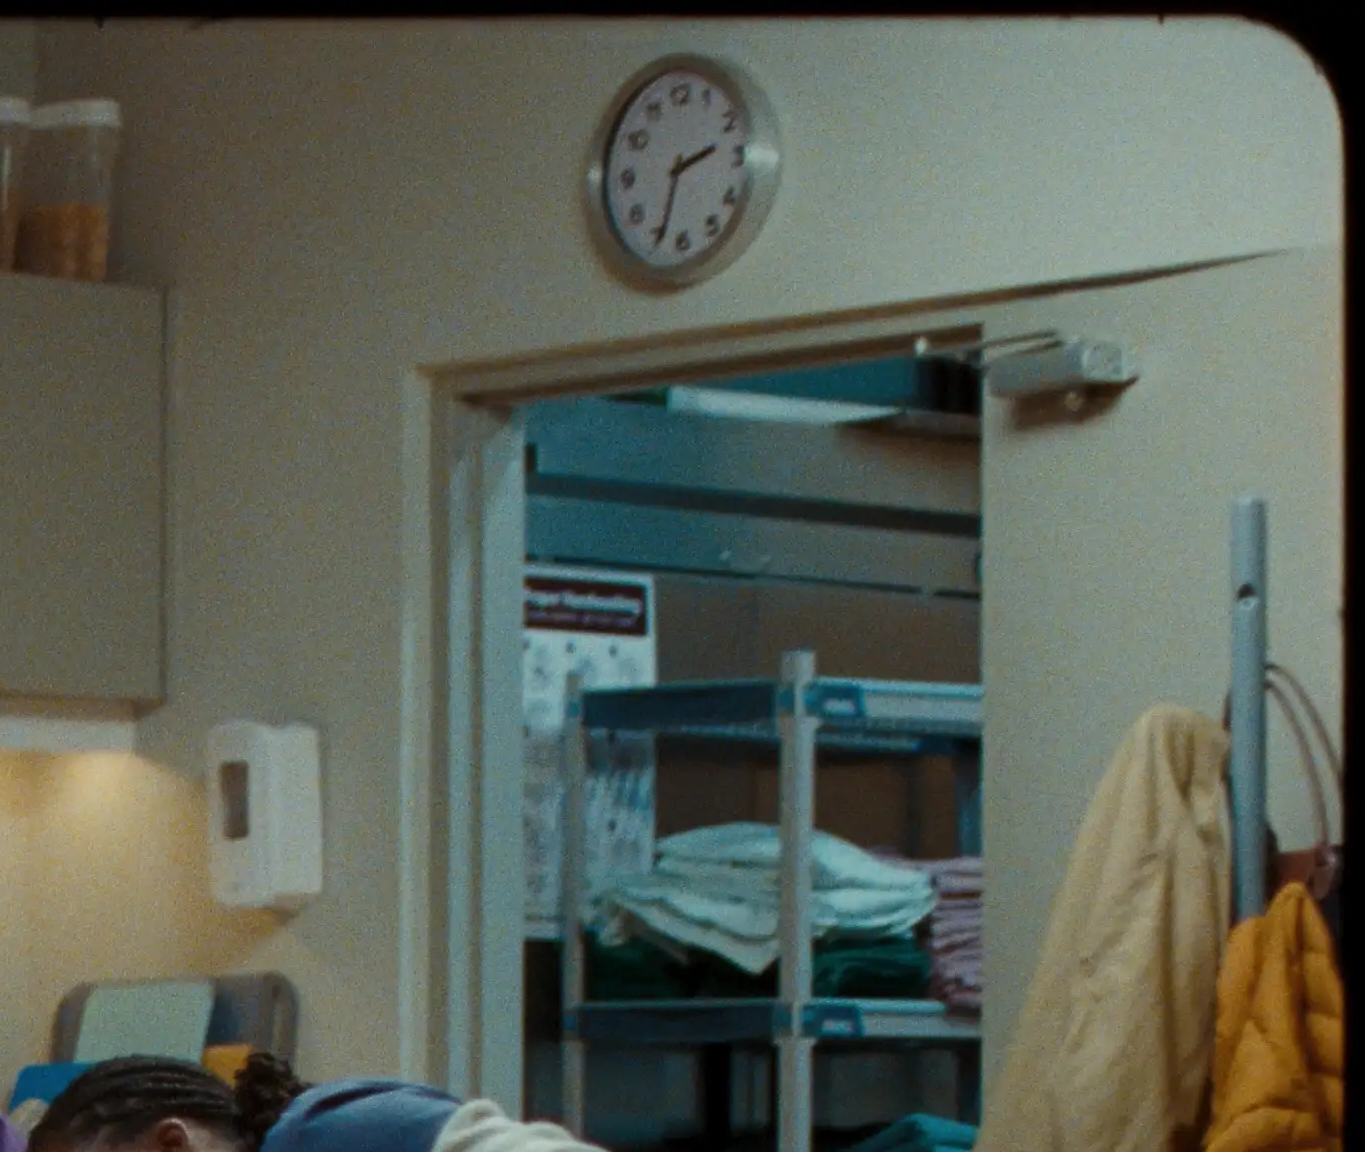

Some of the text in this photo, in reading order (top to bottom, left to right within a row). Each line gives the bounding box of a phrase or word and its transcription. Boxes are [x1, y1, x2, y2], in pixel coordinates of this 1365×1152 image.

[669, 83, 691, 107] 12
[722, 111, 743, 134] 2
[627, 128, 650, 151] 10
[731, 144, 745, 168] 3
[620, 167, 636, 190] 9
[722, 186, 737, 206] 4
[629, 203, 645, 225] 8
[705, 213, 719, 237] 5
[675, 229, 691, 252] 6
